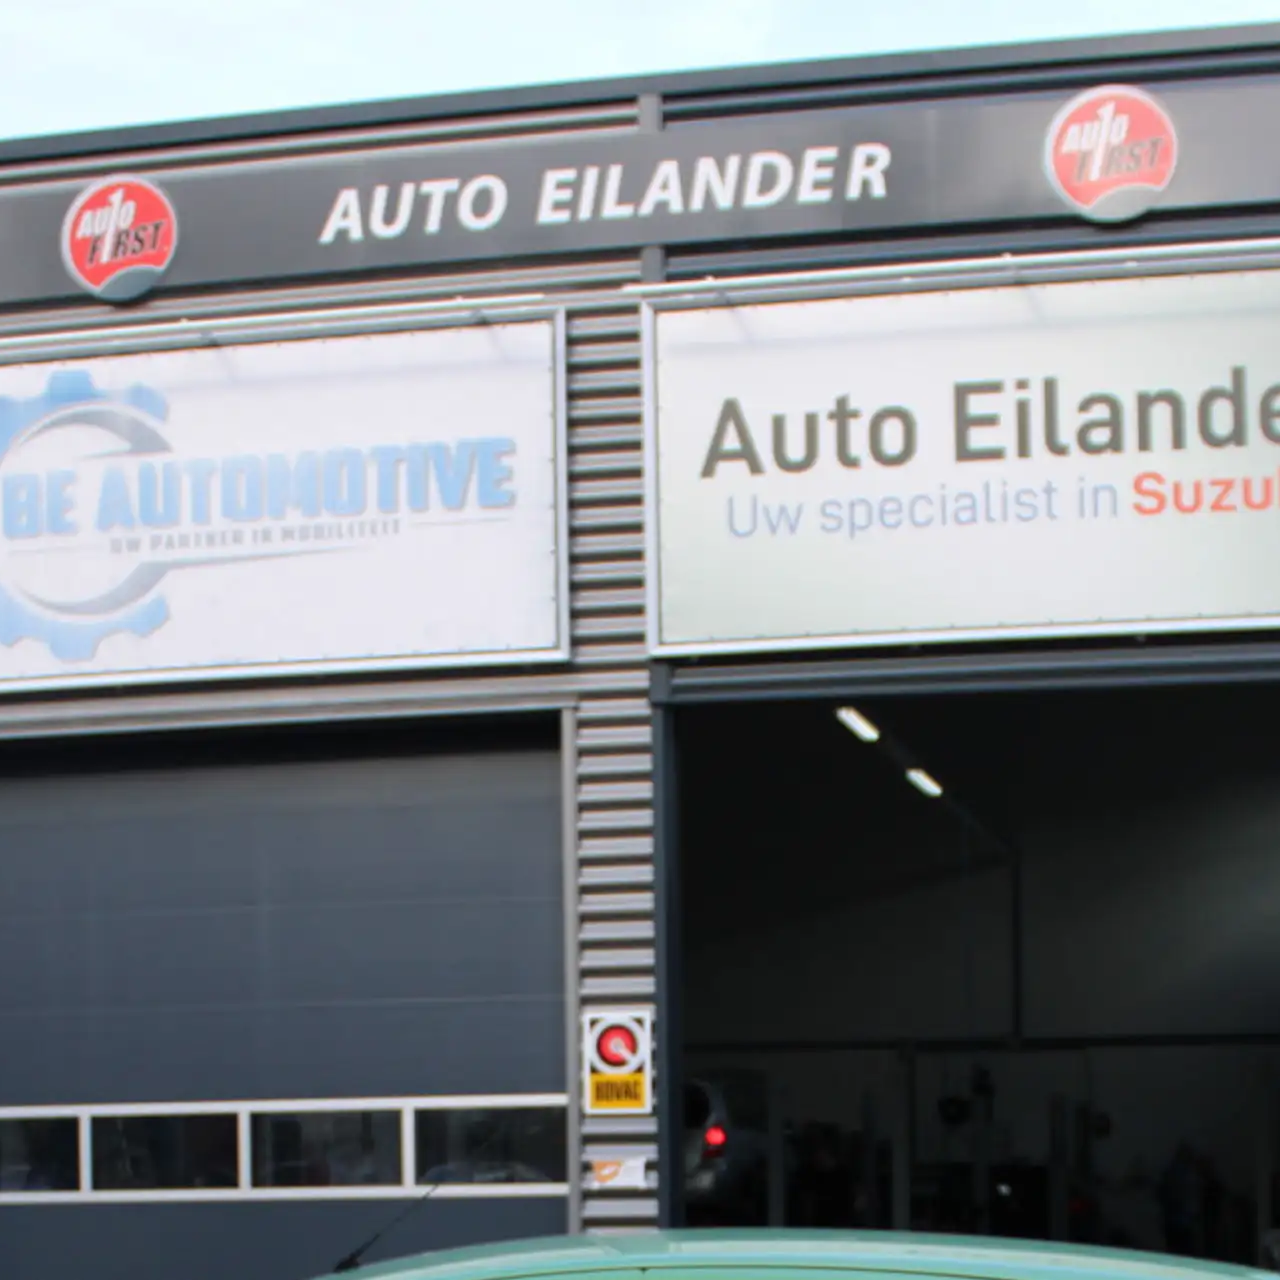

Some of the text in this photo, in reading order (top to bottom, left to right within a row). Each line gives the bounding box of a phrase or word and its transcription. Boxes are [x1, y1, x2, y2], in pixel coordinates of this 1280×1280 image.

[319, 142, 892, 244] AUTO EILANDER
[700, 393, 918, 479] Auto
[2, 435, 518, 541] BE AUTOMOTIVE
[727, 493, 804, 539] Uw
[819, 479, 1058, 540] specialist
[1078, 475, 1118, 519] in
